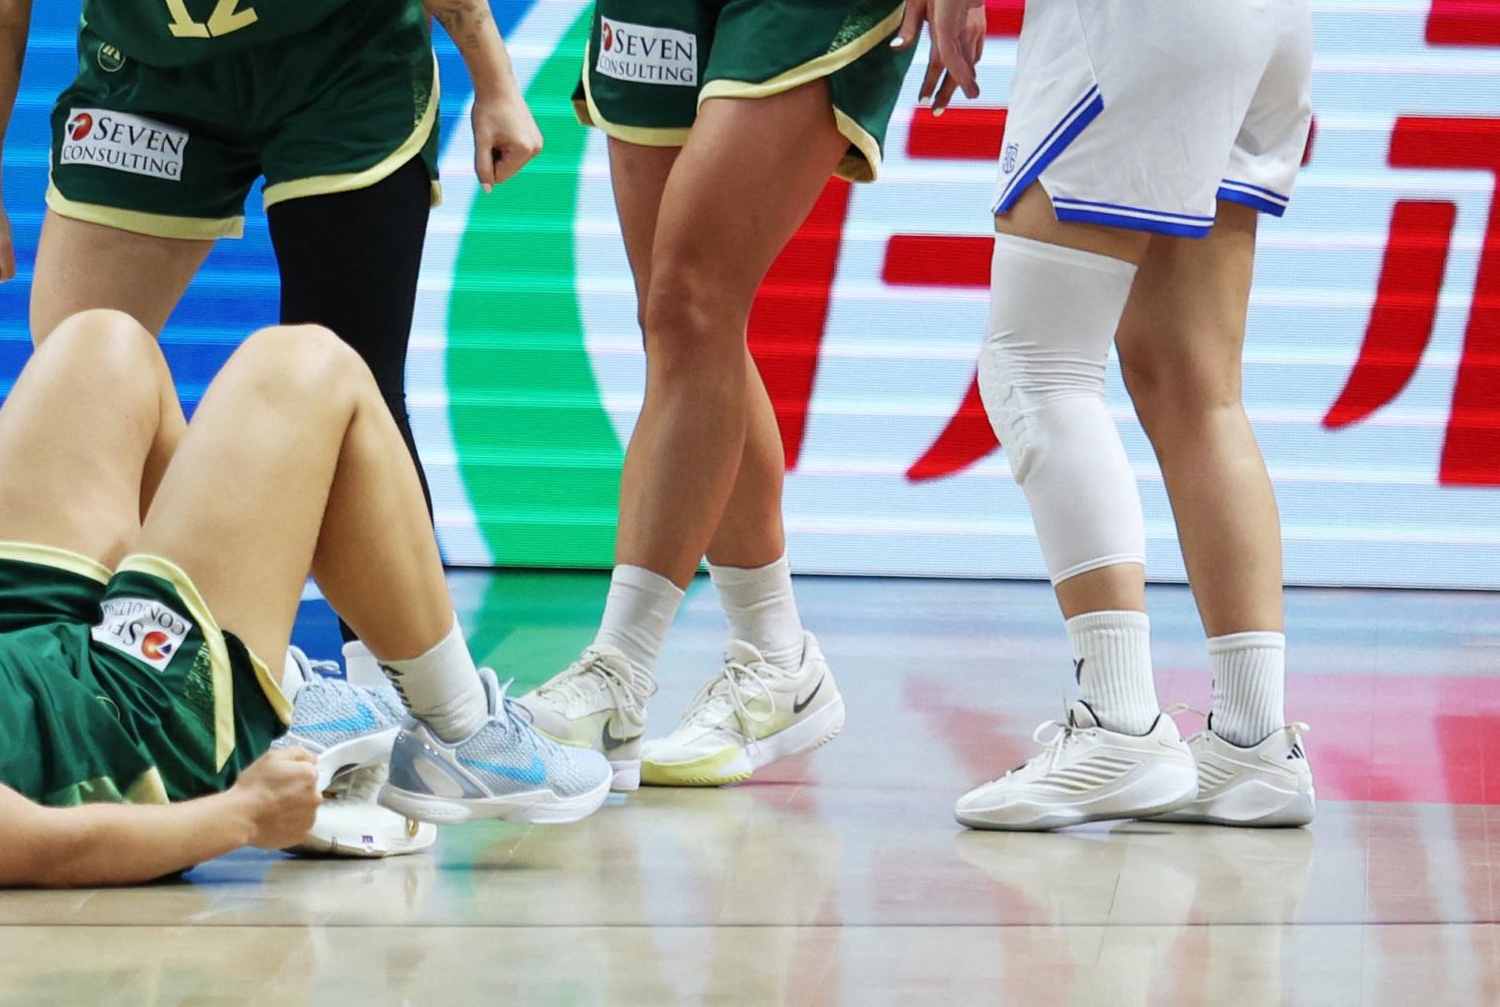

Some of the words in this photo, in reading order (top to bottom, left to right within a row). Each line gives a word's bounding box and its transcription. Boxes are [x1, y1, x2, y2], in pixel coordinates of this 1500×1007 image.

[614, 28, 693, 61] SEVEN
[599, 55, 693, 83] CONSULTING
[93, 116, 184, 156] SEVEN
[62, 144, 180, 177] CONSULTING
